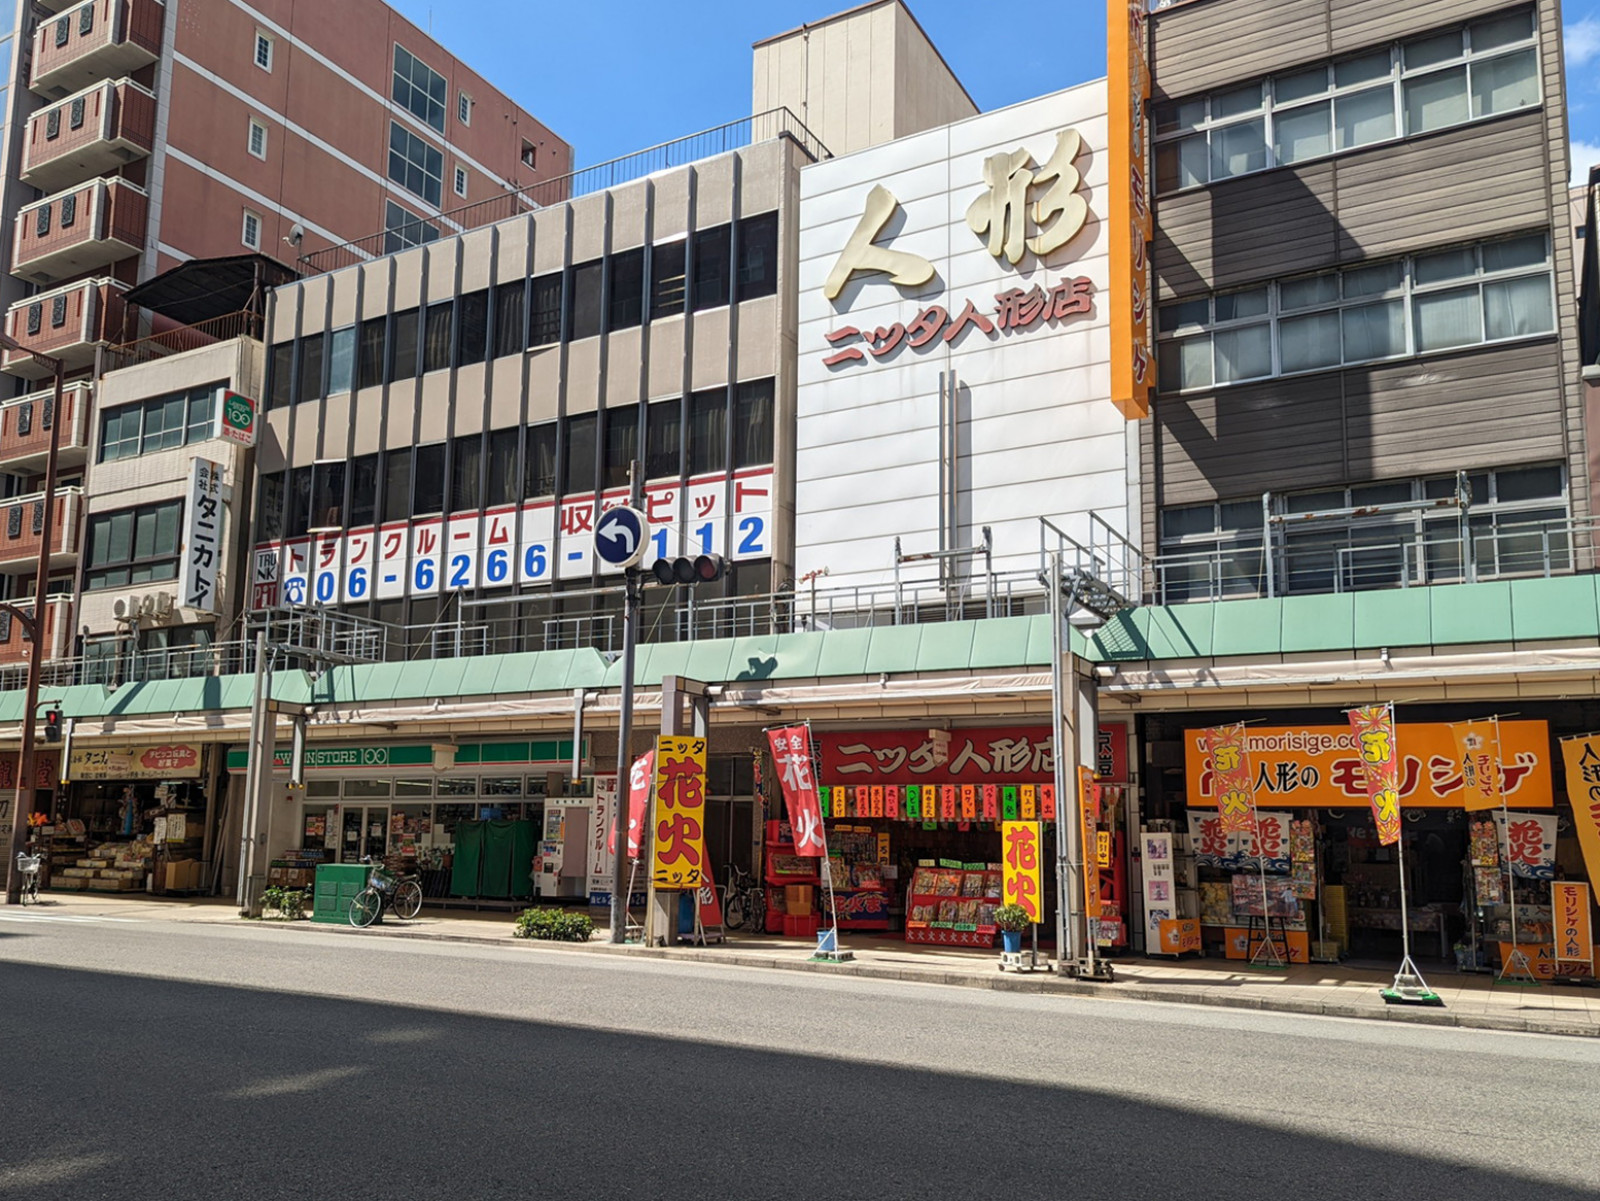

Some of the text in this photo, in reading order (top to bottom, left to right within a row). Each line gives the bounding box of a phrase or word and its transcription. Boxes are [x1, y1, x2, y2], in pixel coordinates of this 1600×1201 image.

[824, 128, 1088, 301] 人形
[822, 275, 1092, 366] ニッタ人形店
[289, 482, 768, 573] トランクルーム 収ピット
[317, 517, 763, 602] 06-6266-112
[317, 751, 357, 764] STORE
[361, 748, 387, 764] 100
[659, 740, 705, 755] ニッタ
[774, 735, 803, 751] 安全
[1253, 762, 1319, 792] 人形の
[594, 794, 605, 874] トランクルーム
[658, 756, 703, 866] 花火
[777, 753, 825, 849] 花火
[656, 868, 700, 884] ニッタ
[1006, 825, 1037, 917] 花火
